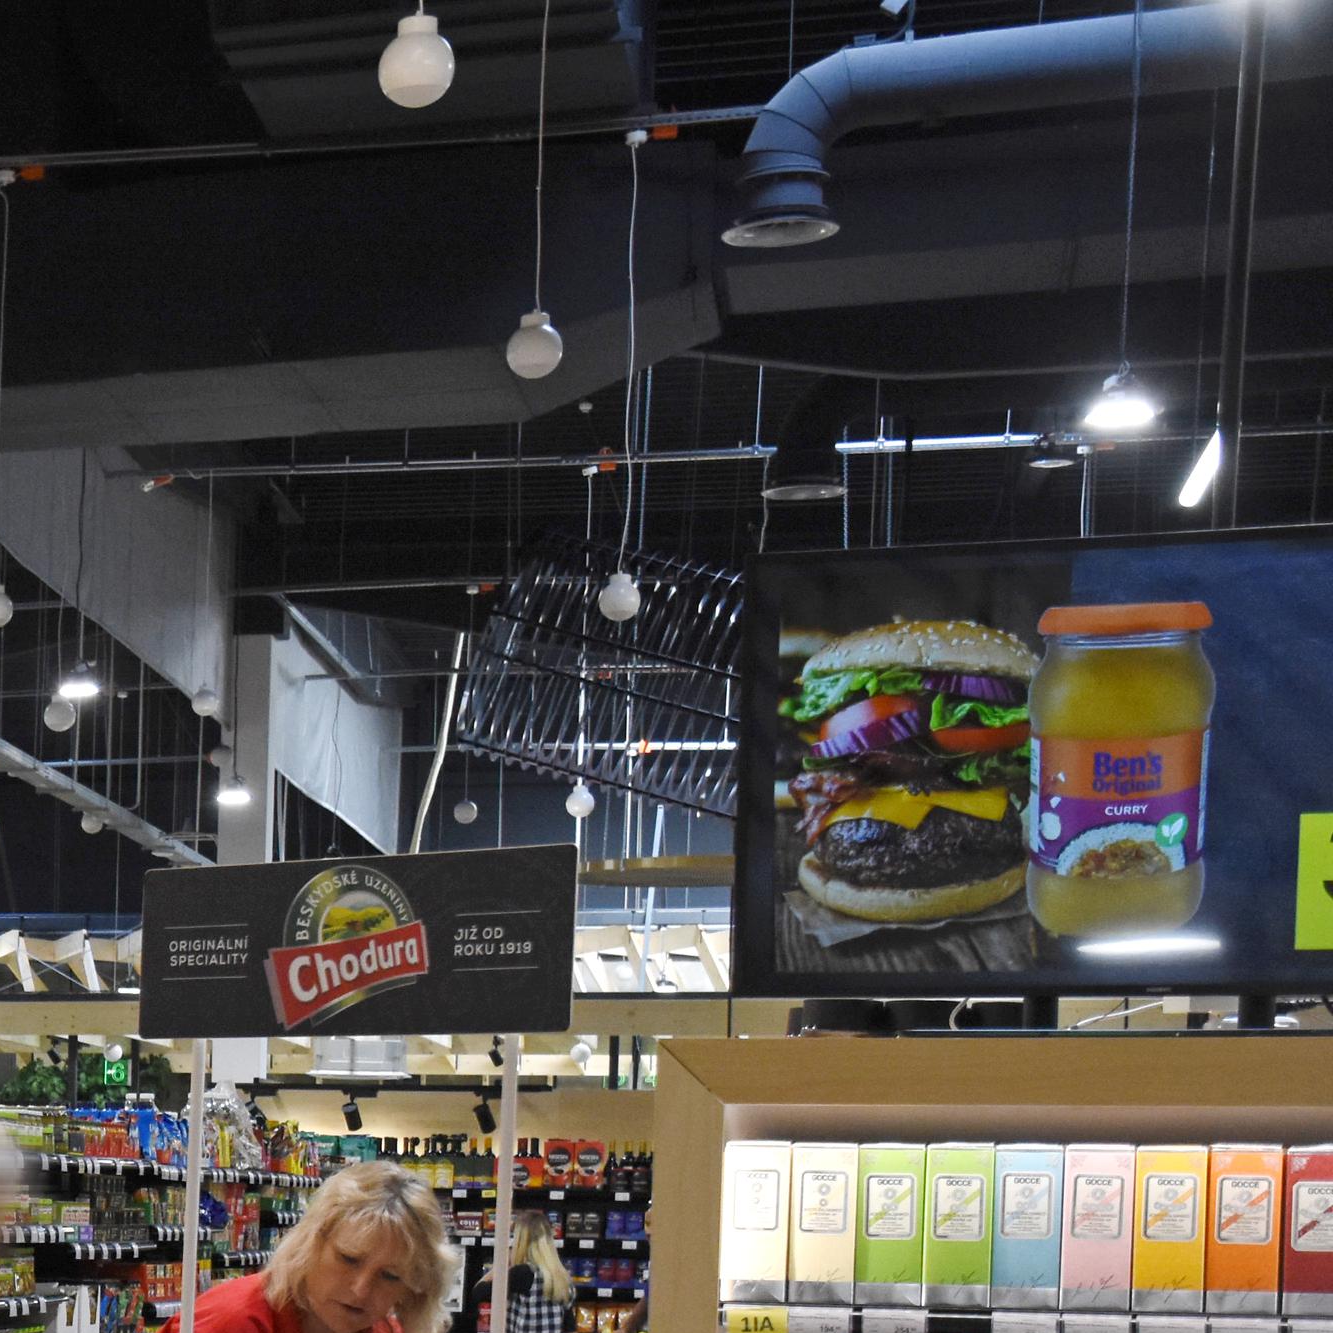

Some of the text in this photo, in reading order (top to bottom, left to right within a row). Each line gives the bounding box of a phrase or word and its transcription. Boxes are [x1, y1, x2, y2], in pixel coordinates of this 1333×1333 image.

[1094, 751, 1163, 777] Ben's
[1104, 804, 1148, 816] CURRY
[295, 869, 410, 941] BESKYDSKÉ UZENINY
[454, 926, 504, 941] JIŽ OD
[169, 936, 248, 953] ORIGINÁLNÍ
[454, 941, 532, 957] ROKU 1919
[170, 952, 248, 968] SPECIALITY
[288, 937, 419, 1003] Chodura
[1307, 1187, 1333, 1195] GOCC
